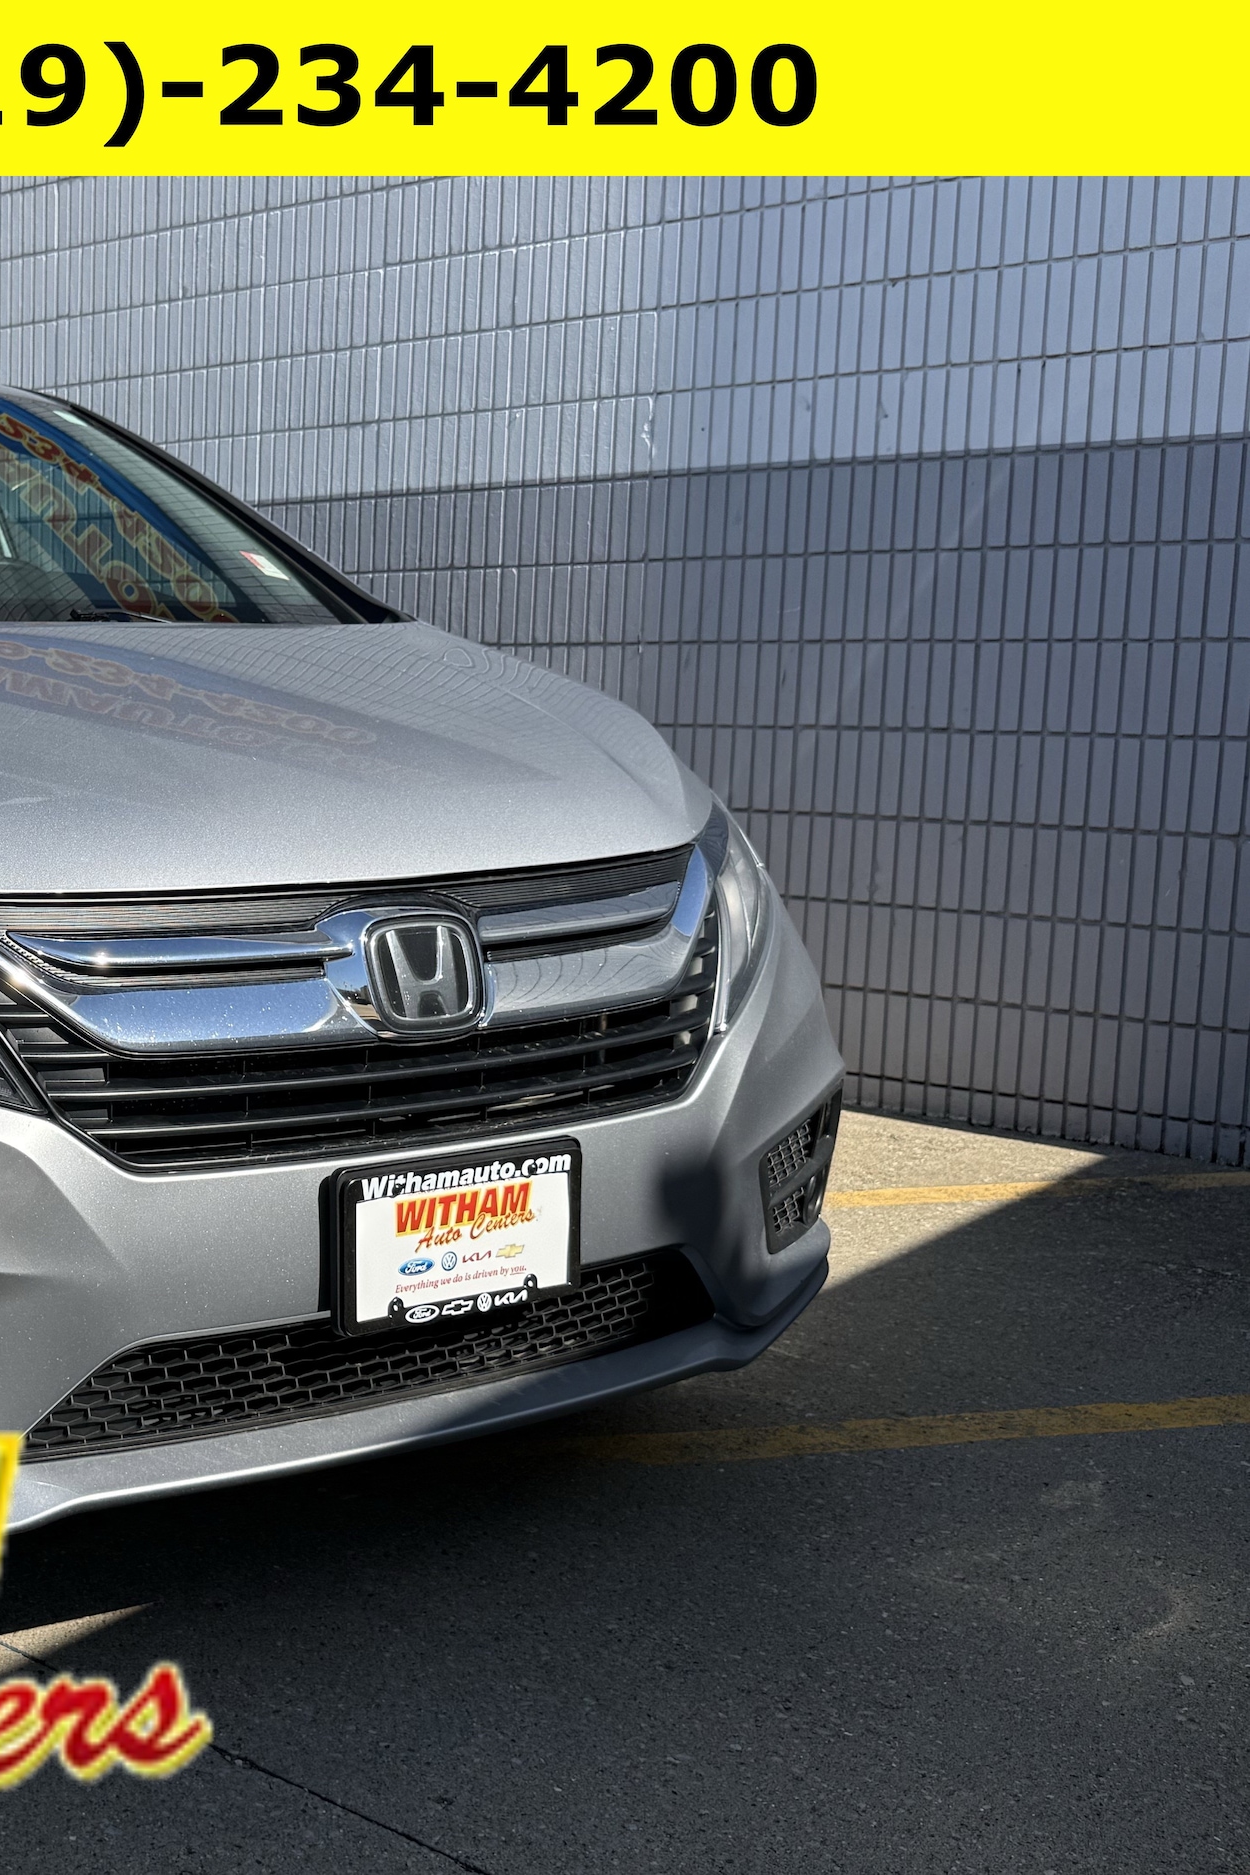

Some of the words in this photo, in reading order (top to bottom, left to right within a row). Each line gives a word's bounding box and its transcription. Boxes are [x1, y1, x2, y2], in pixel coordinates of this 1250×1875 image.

[361, 1153, 571, 1201] Withamauto.com
[395, 1181, 532, 1236] WITHAM
[415, 1226, 463, 1252] Auto
[470, 1209, 536, 1240] Centers
[395, 1277, 439, 1294] Everything
[440, 1276, 452, 1285] we
[452, 1273, 463, 1283] do
[464, 1272, 471, 1281] is
[473, 1268, 498, 1279] driven
[500, 1266, 509, 1276] by
[403, 1258, 429, 1274] Ford
